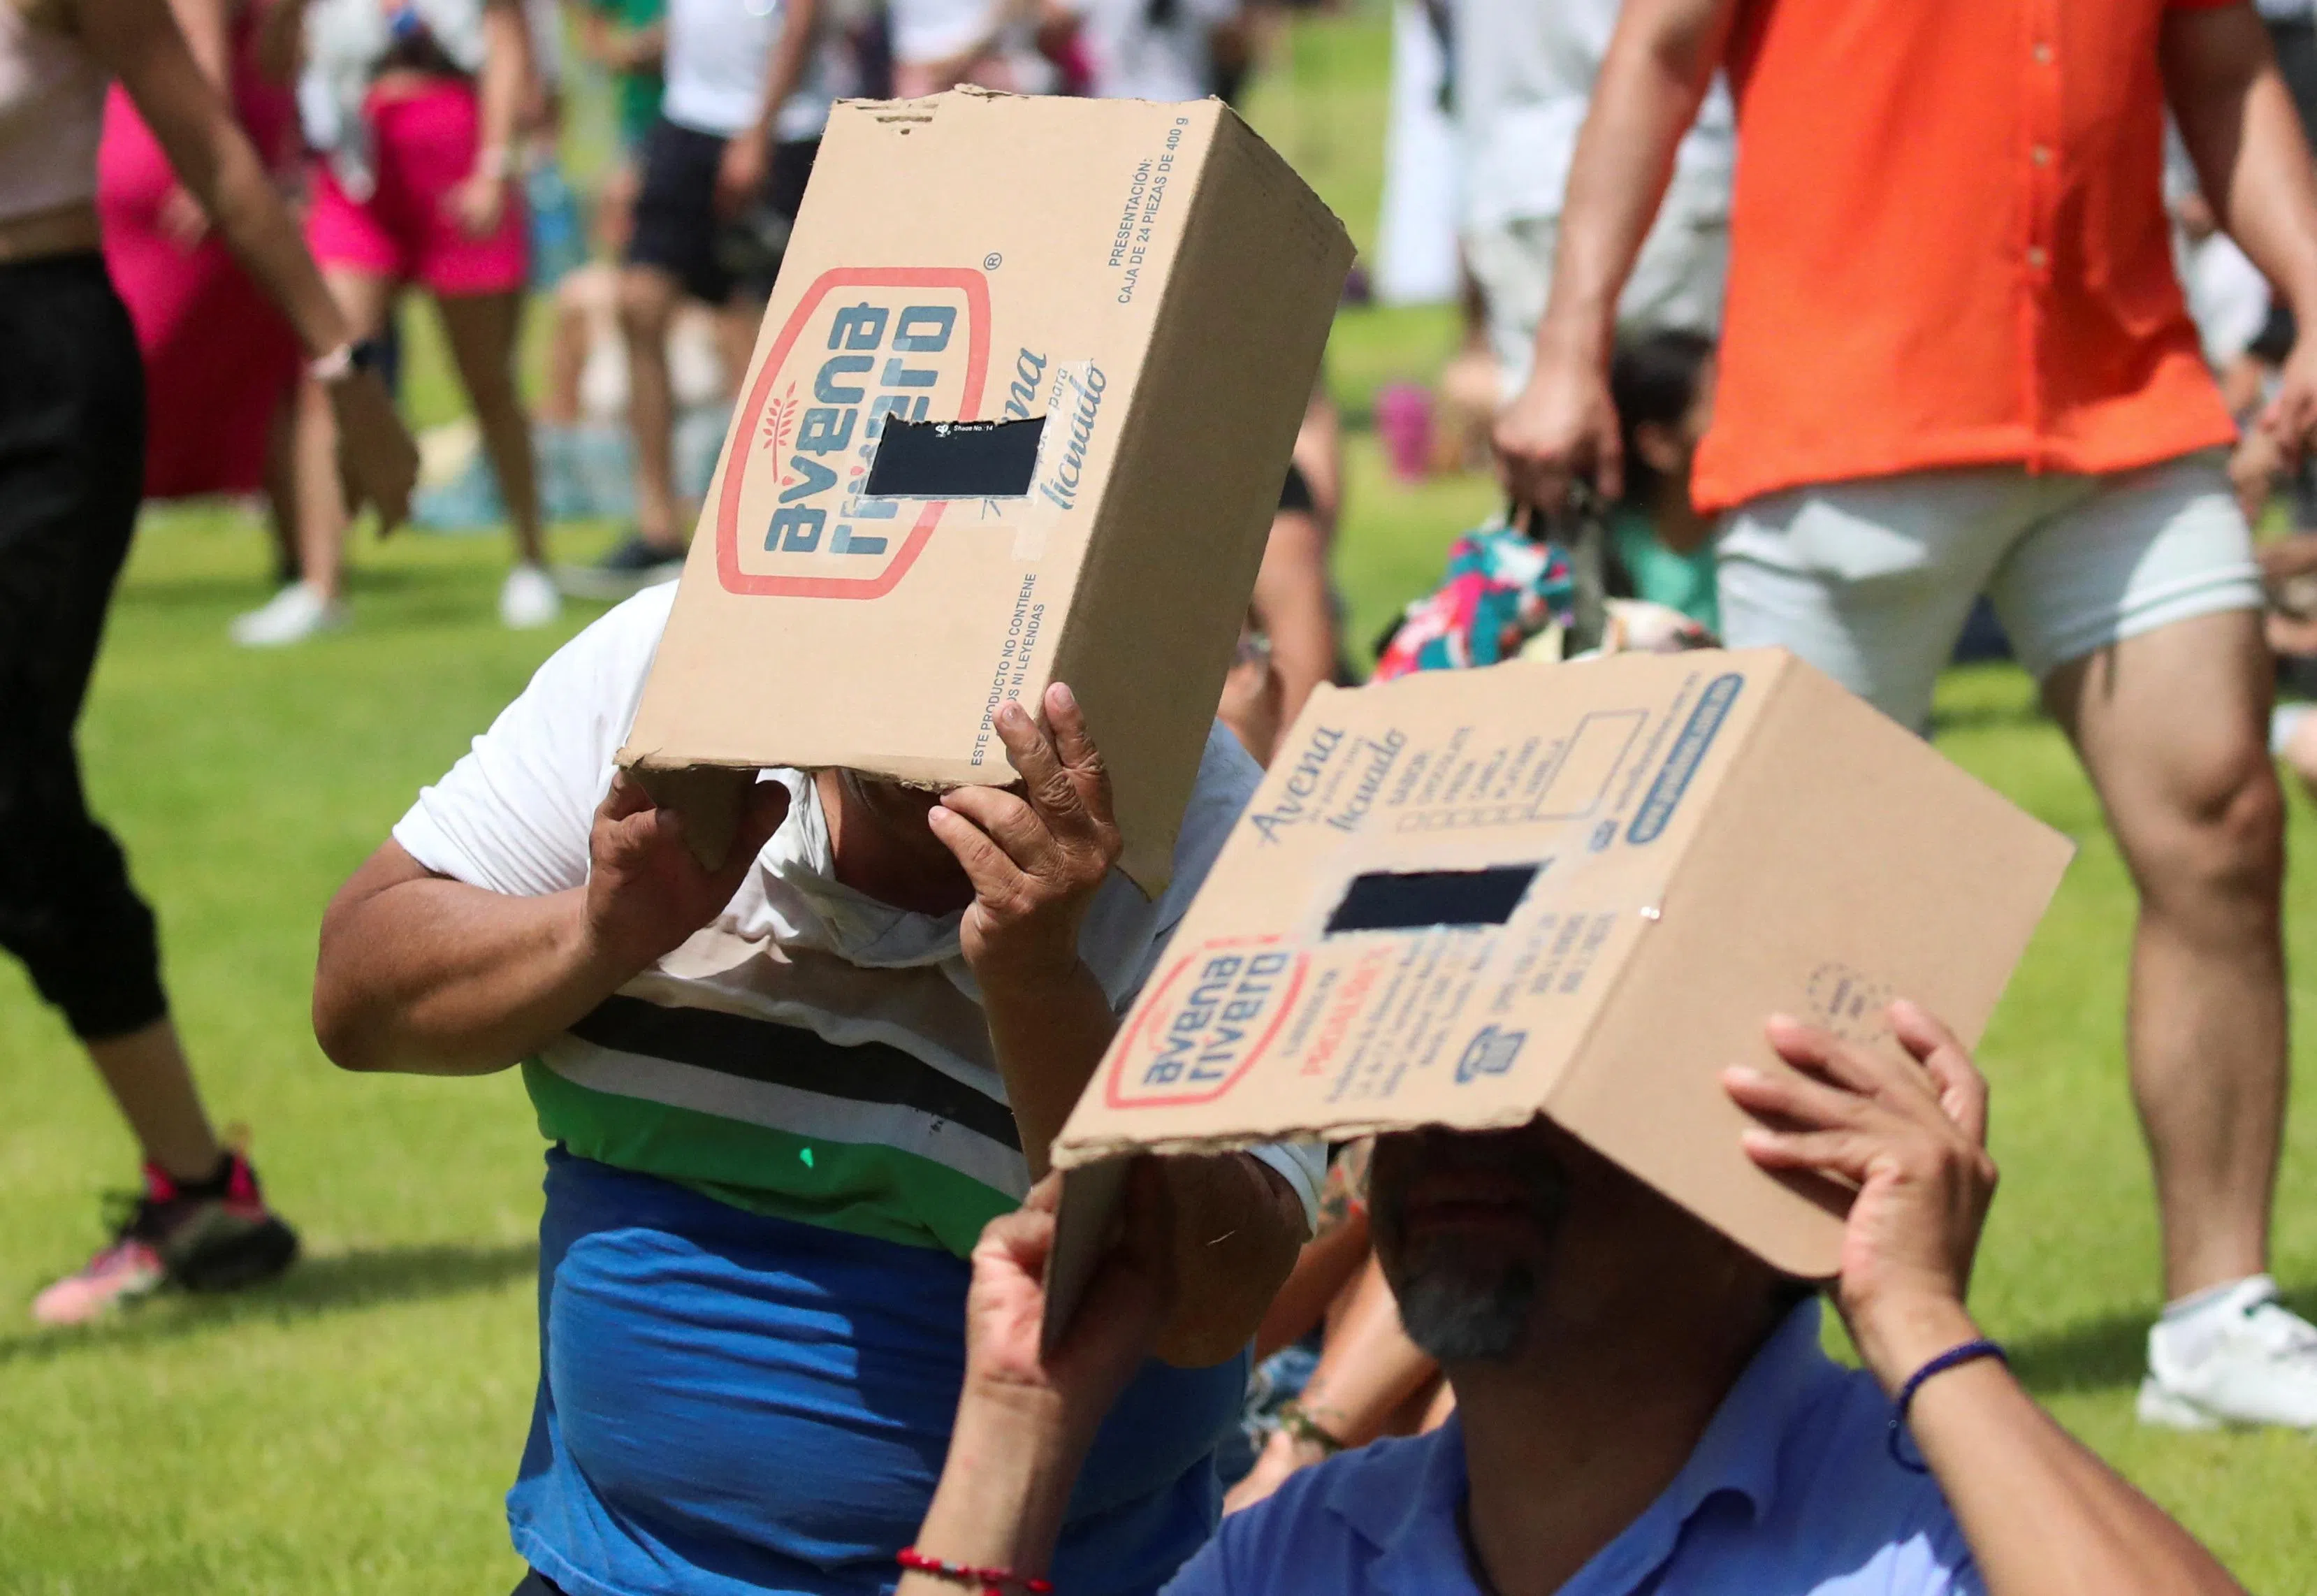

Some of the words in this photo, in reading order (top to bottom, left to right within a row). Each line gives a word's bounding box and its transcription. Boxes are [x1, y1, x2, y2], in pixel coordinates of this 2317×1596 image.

[1158, 154, 1175, 172] DE
[1166, 129, 1182, 151] 400
[1109, 159, 1153, 266] PRESENTACIÓN:
[1137, 228, 1151, 242] 24
[1142, 177, 1167, 224] PIEZAS
[1118, 268, 1140, 303] CAJA
[1130, 246, 1146, 264] DE
[764, 302, 889, 553] avena
[829, 306, 957, 555] riero
[1040, 358, 1107, 510] licuado
[1048, 368, 1068, 409] para
[971, 734, 989, 766] ESTE
[1002, 640, 1016, 658] NO
[1010, 574, 1036, 634] CONTIENE
[1012, 673, 1024, 685] NI
[1019, 604, 1045, 670] LEYENDAS
[1252, 724, 1345, 846] Avena
[1142, 953, 1243, 1086] avena
[1186, 951, 1294, 1084] rivero
